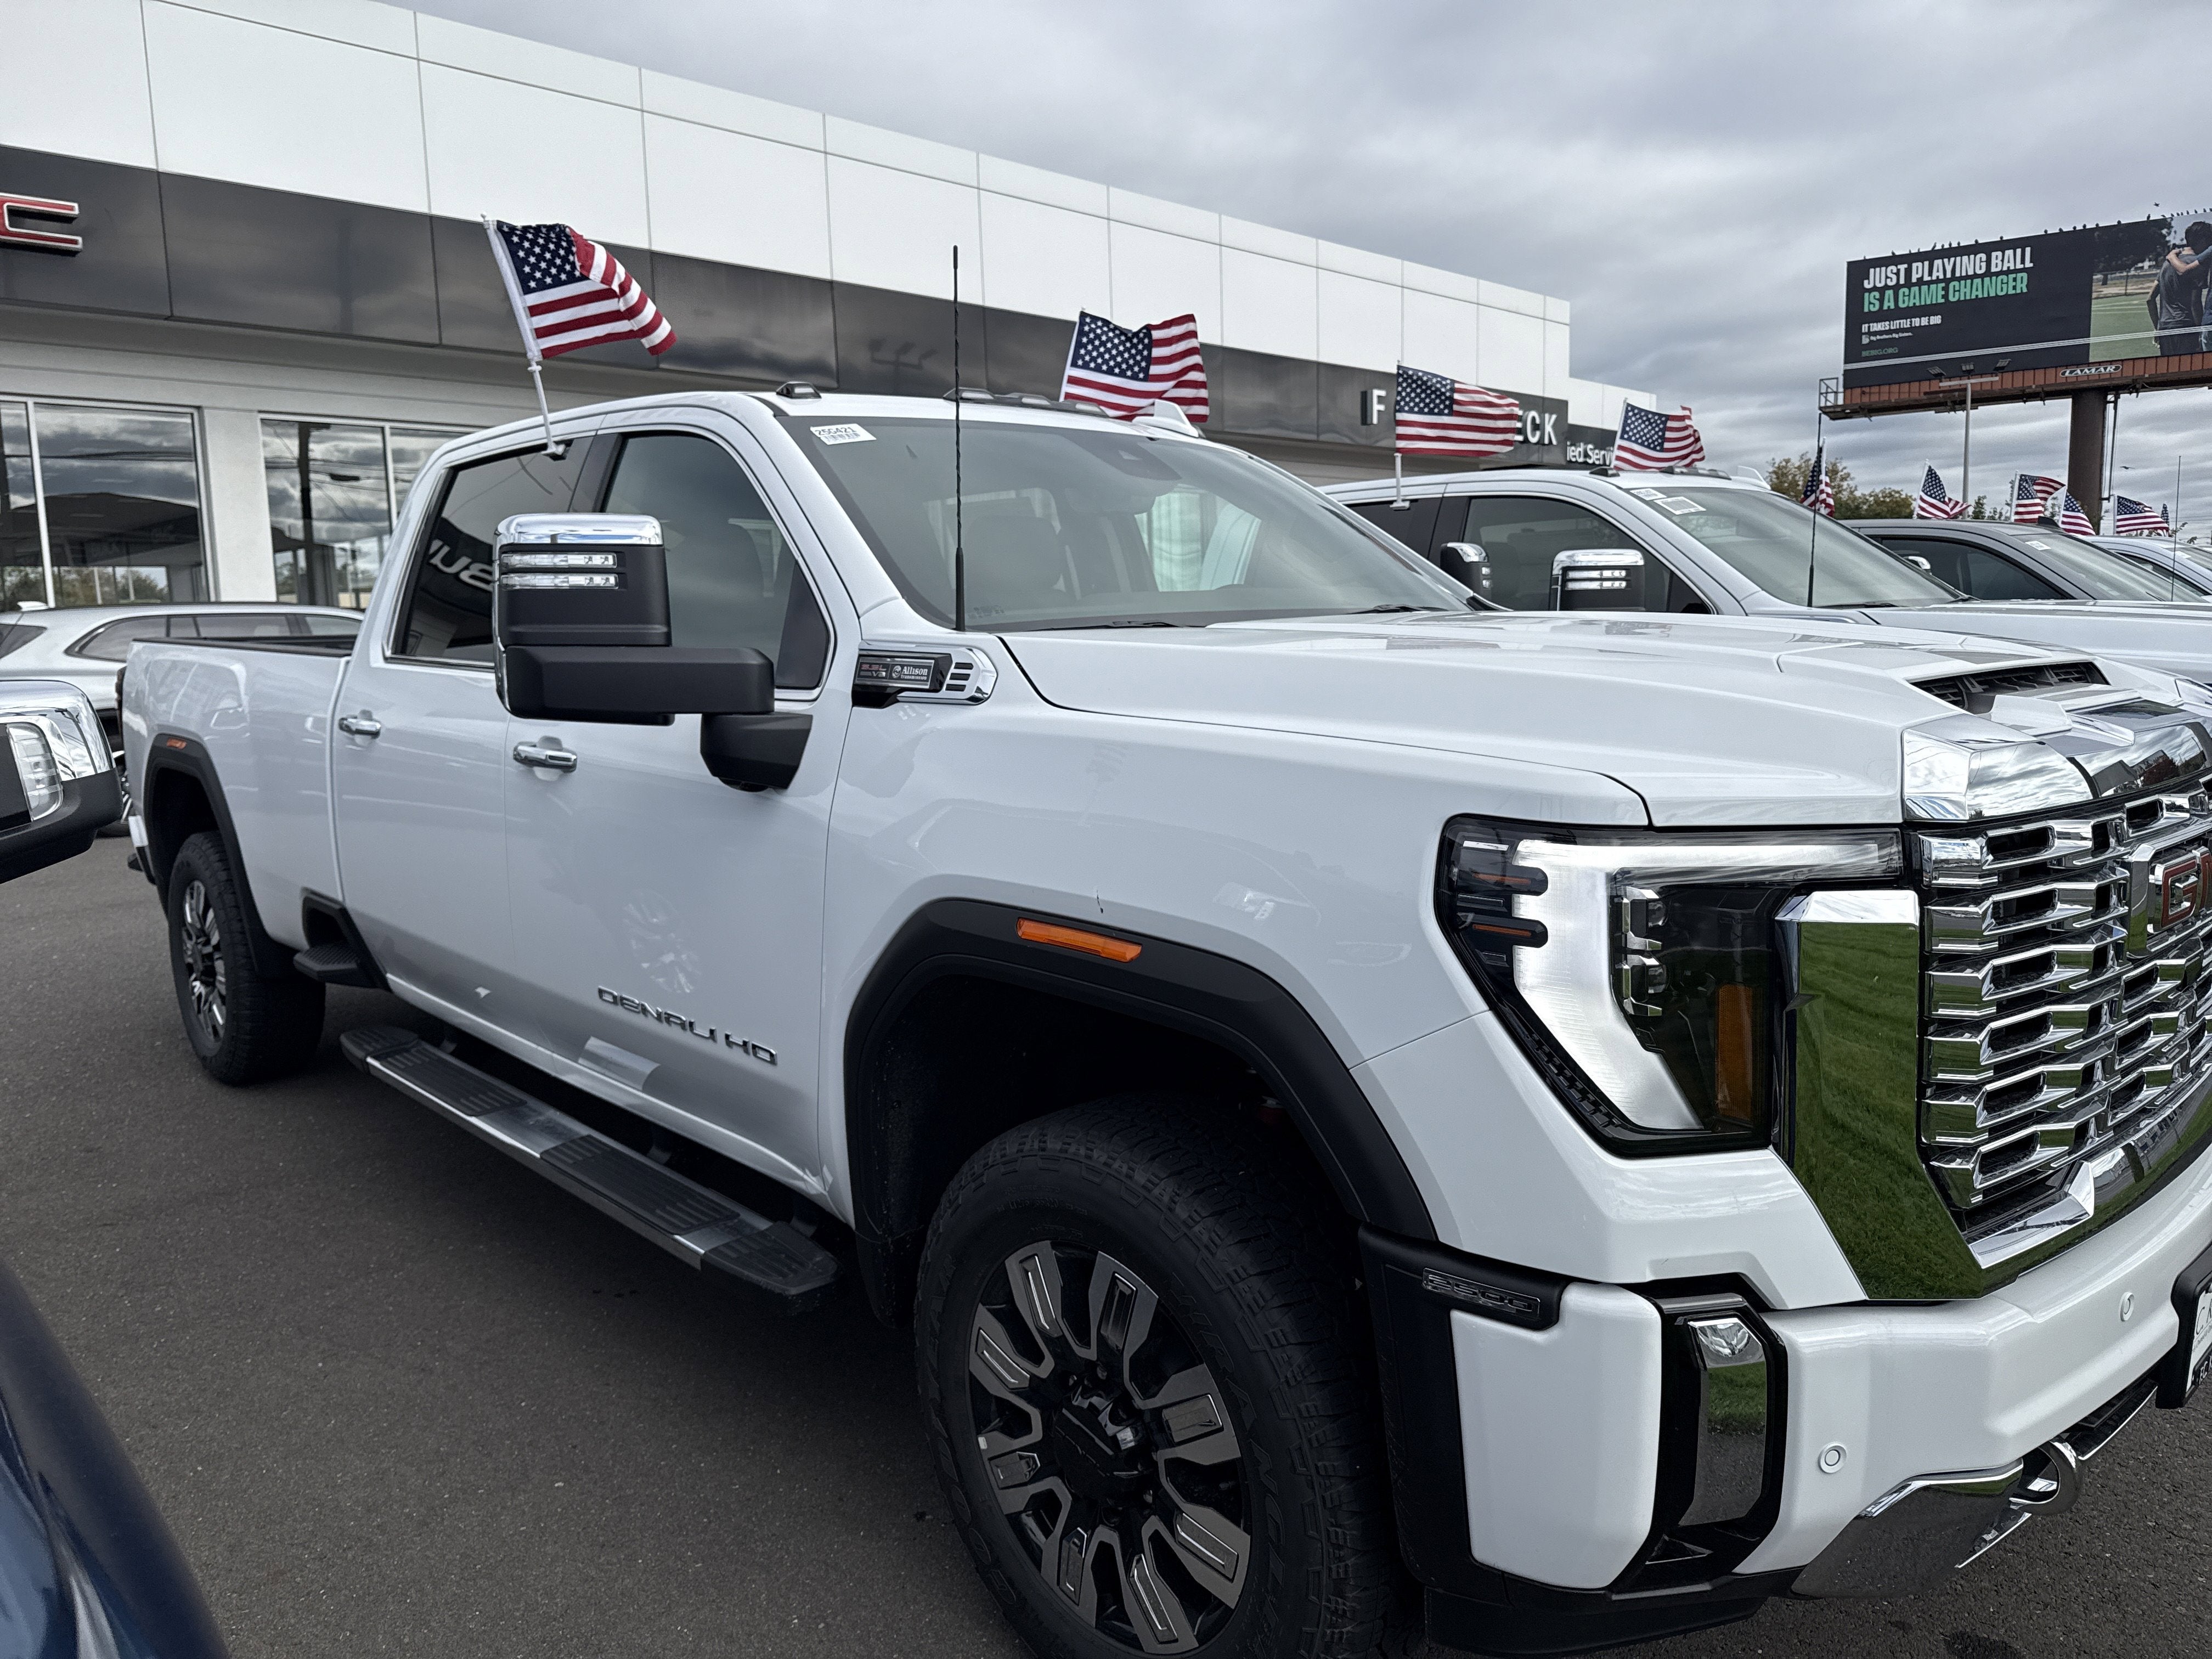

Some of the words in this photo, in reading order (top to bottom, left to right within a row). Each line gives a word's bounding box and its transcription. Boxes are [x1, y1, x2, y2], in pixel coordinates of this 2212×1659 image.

[1863, 263, 1908, 289] JUST
[1911, 253, 1987, 283] PLAYING
[1990, 247, 2034, 273] BALL
[1864, 291, 1880, 312] IS
[1882, 289, 1895, 310] A
[1898, 283, 1945, 308] GAME
[1948, 272, 2028, 302] CHANGER
[1861, 323, 1869, 332] IT
[1870, 321, 1890, 332] TAKES
[1890, 318, 1911, 330] LITTLE
[1911, 317, 1920, 327] TO
[1921, 317, 1929, 326] BE
[1929, 315, 1942, 325] BIG
[2064, 366, 2116, 376] LAMAR
[901, 665, 928, 675] Allison
[598, 985, 717, 1043] DENALI
[724, 1031, 777, 1065] HD
[1428, 1274, 1533, 1312] 2500
